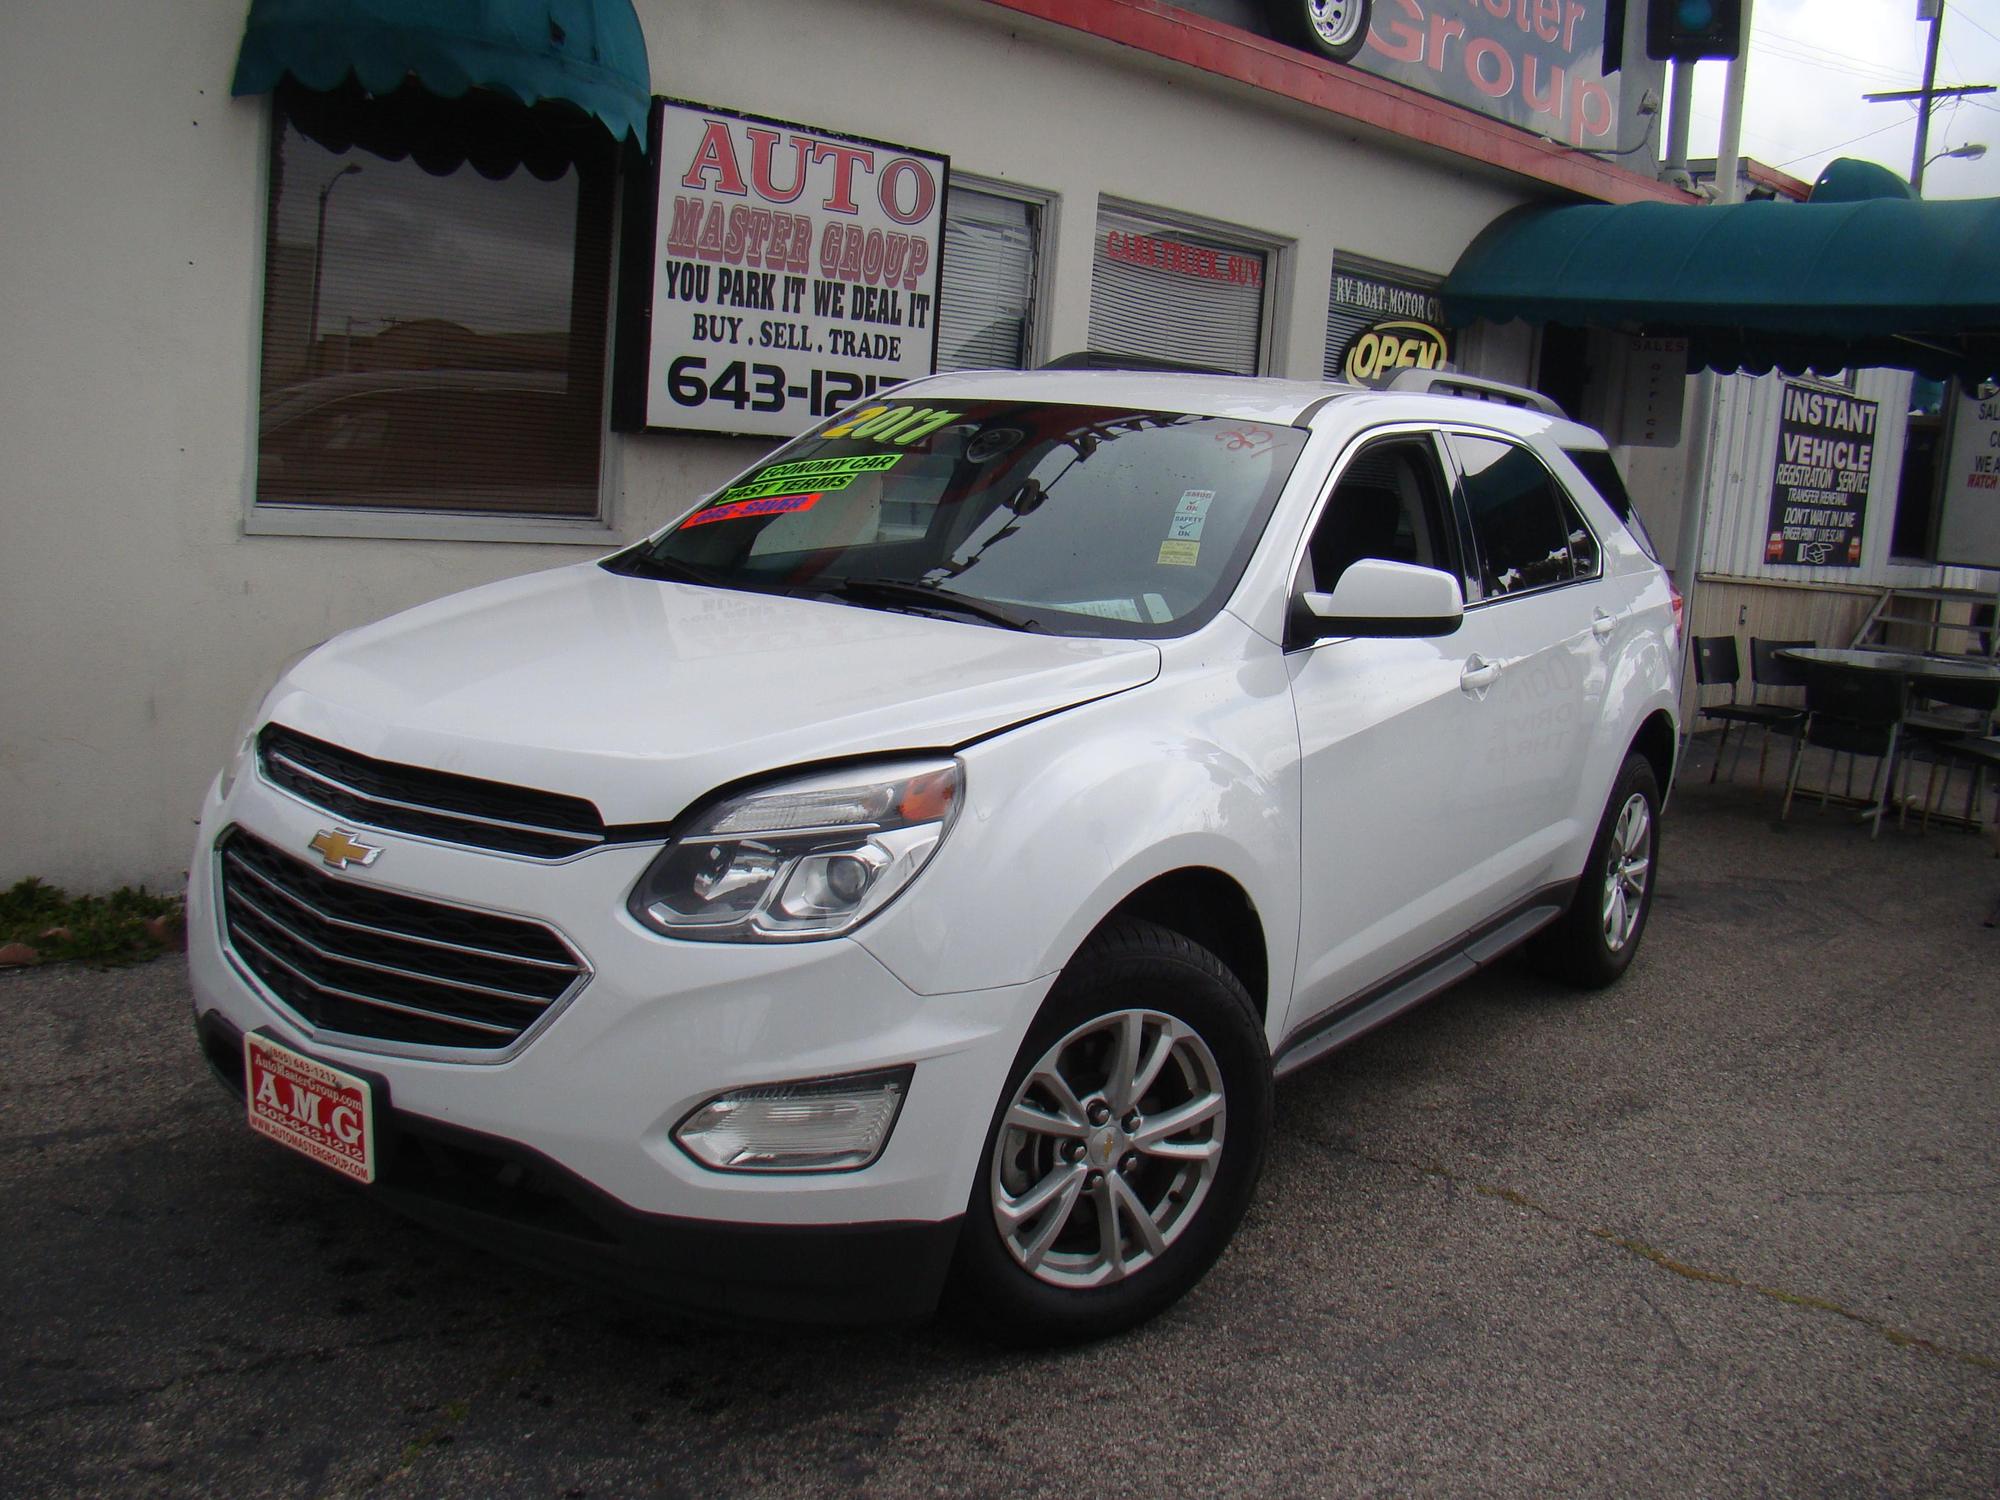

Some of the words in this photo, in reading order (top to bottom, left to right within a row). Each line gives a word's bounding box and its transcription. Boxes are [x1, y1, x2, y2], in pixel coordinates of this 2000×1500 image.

[1365, 0, 1612, 147] Group
[682, 118, 936, 225] AUTO
[667, 196, 813, 275] MASTER
[820, 222, 929, 291] GROUP
[666, 260, 711, 303] YOU
[717, 267, 776, 312] PARK
[782, 276, 806, 314] IT
[814, 279, 845, 320] WE
[851, 284, 902, 328] DEAL
[908, 292, 930, 329] IT
[1388, 288, 1425, 320] MOTOR
[828, 328, 901, 362] TRADE
[1353, 333, 1438, 380] OPEN
[1632, 341, 1685, 352] SALES
[1784, 389, 1876, 435] INSTANT
[1978, 403, 2000, 421] SAL
[757, 457, 851, 481] ECONOMY
[849, 455, 895, 469] CAR
[1783, 433, 1871, 471] VEHICLE
[1975, 455, 1992, 473] WE
[721, 480, 774, 501] EASY
[771, 474, 855, 494] TERMS
[1776, 464, 1833, 489] REGISTRATION
[1836, 470, 1869, 493] SERVICE
[1967, 473, 1997, 490] WATCH
[1788, 487, 1819, 503] TRANSFER
[1784, 507, 1810, 524] DON'T
[1810, 509, 1831, 527] WAIT
[1839, 512, 1857, 528] LINE
[255, 1054, 363, 1112] AutoMasterGroup.com
[294, 1057, 337, 1083] 643-1212
[256, 1102, 364, 1160] 805-643-1212
